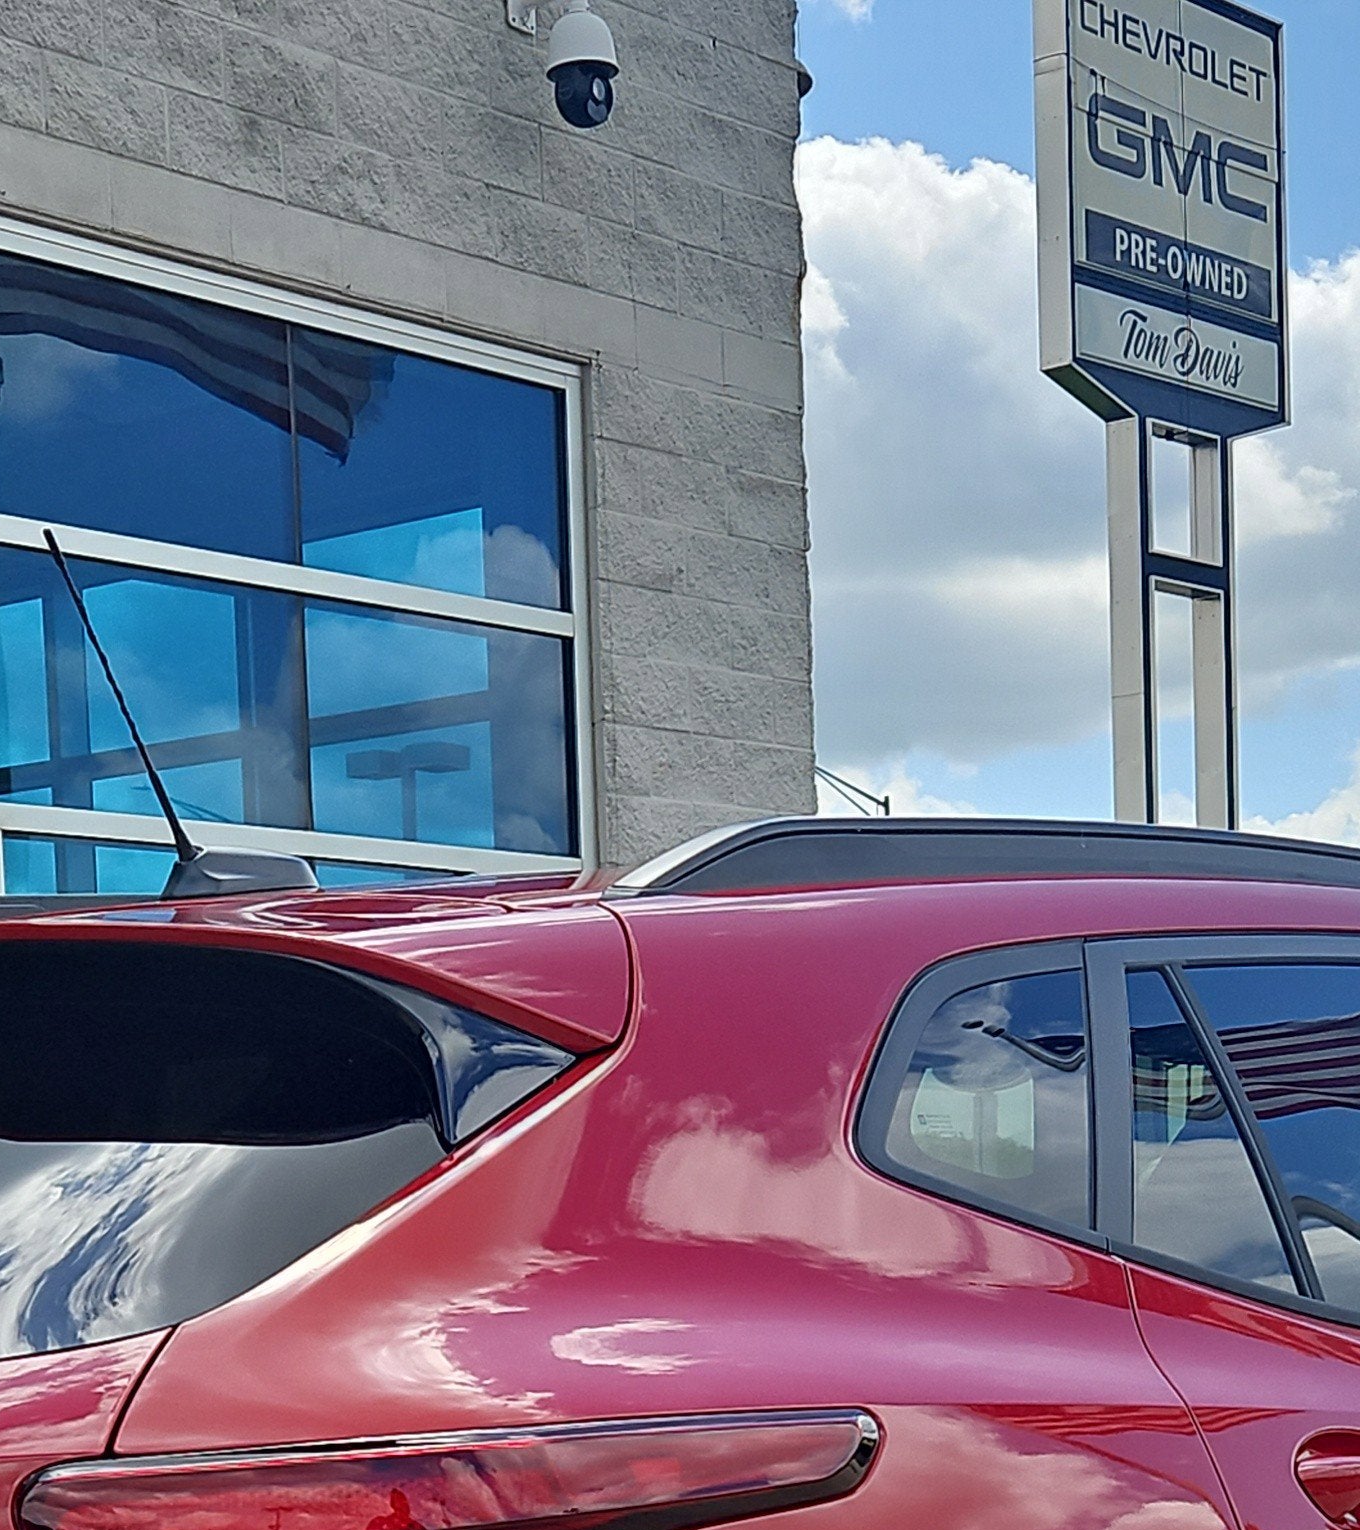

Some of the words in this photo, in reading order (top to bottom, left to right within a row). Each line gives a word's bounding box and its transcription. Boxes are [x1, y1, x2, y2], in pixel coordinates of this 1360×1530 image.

[1080, 0, 1268, 102] CHEVROLET
[1087, 92, 1269, 223] GMC
[1115, 227, 1248, 300] PRE-OWNED
[1119, 308, 1170, 369] Tom
[1173, 326, 1245, 388] Davis
